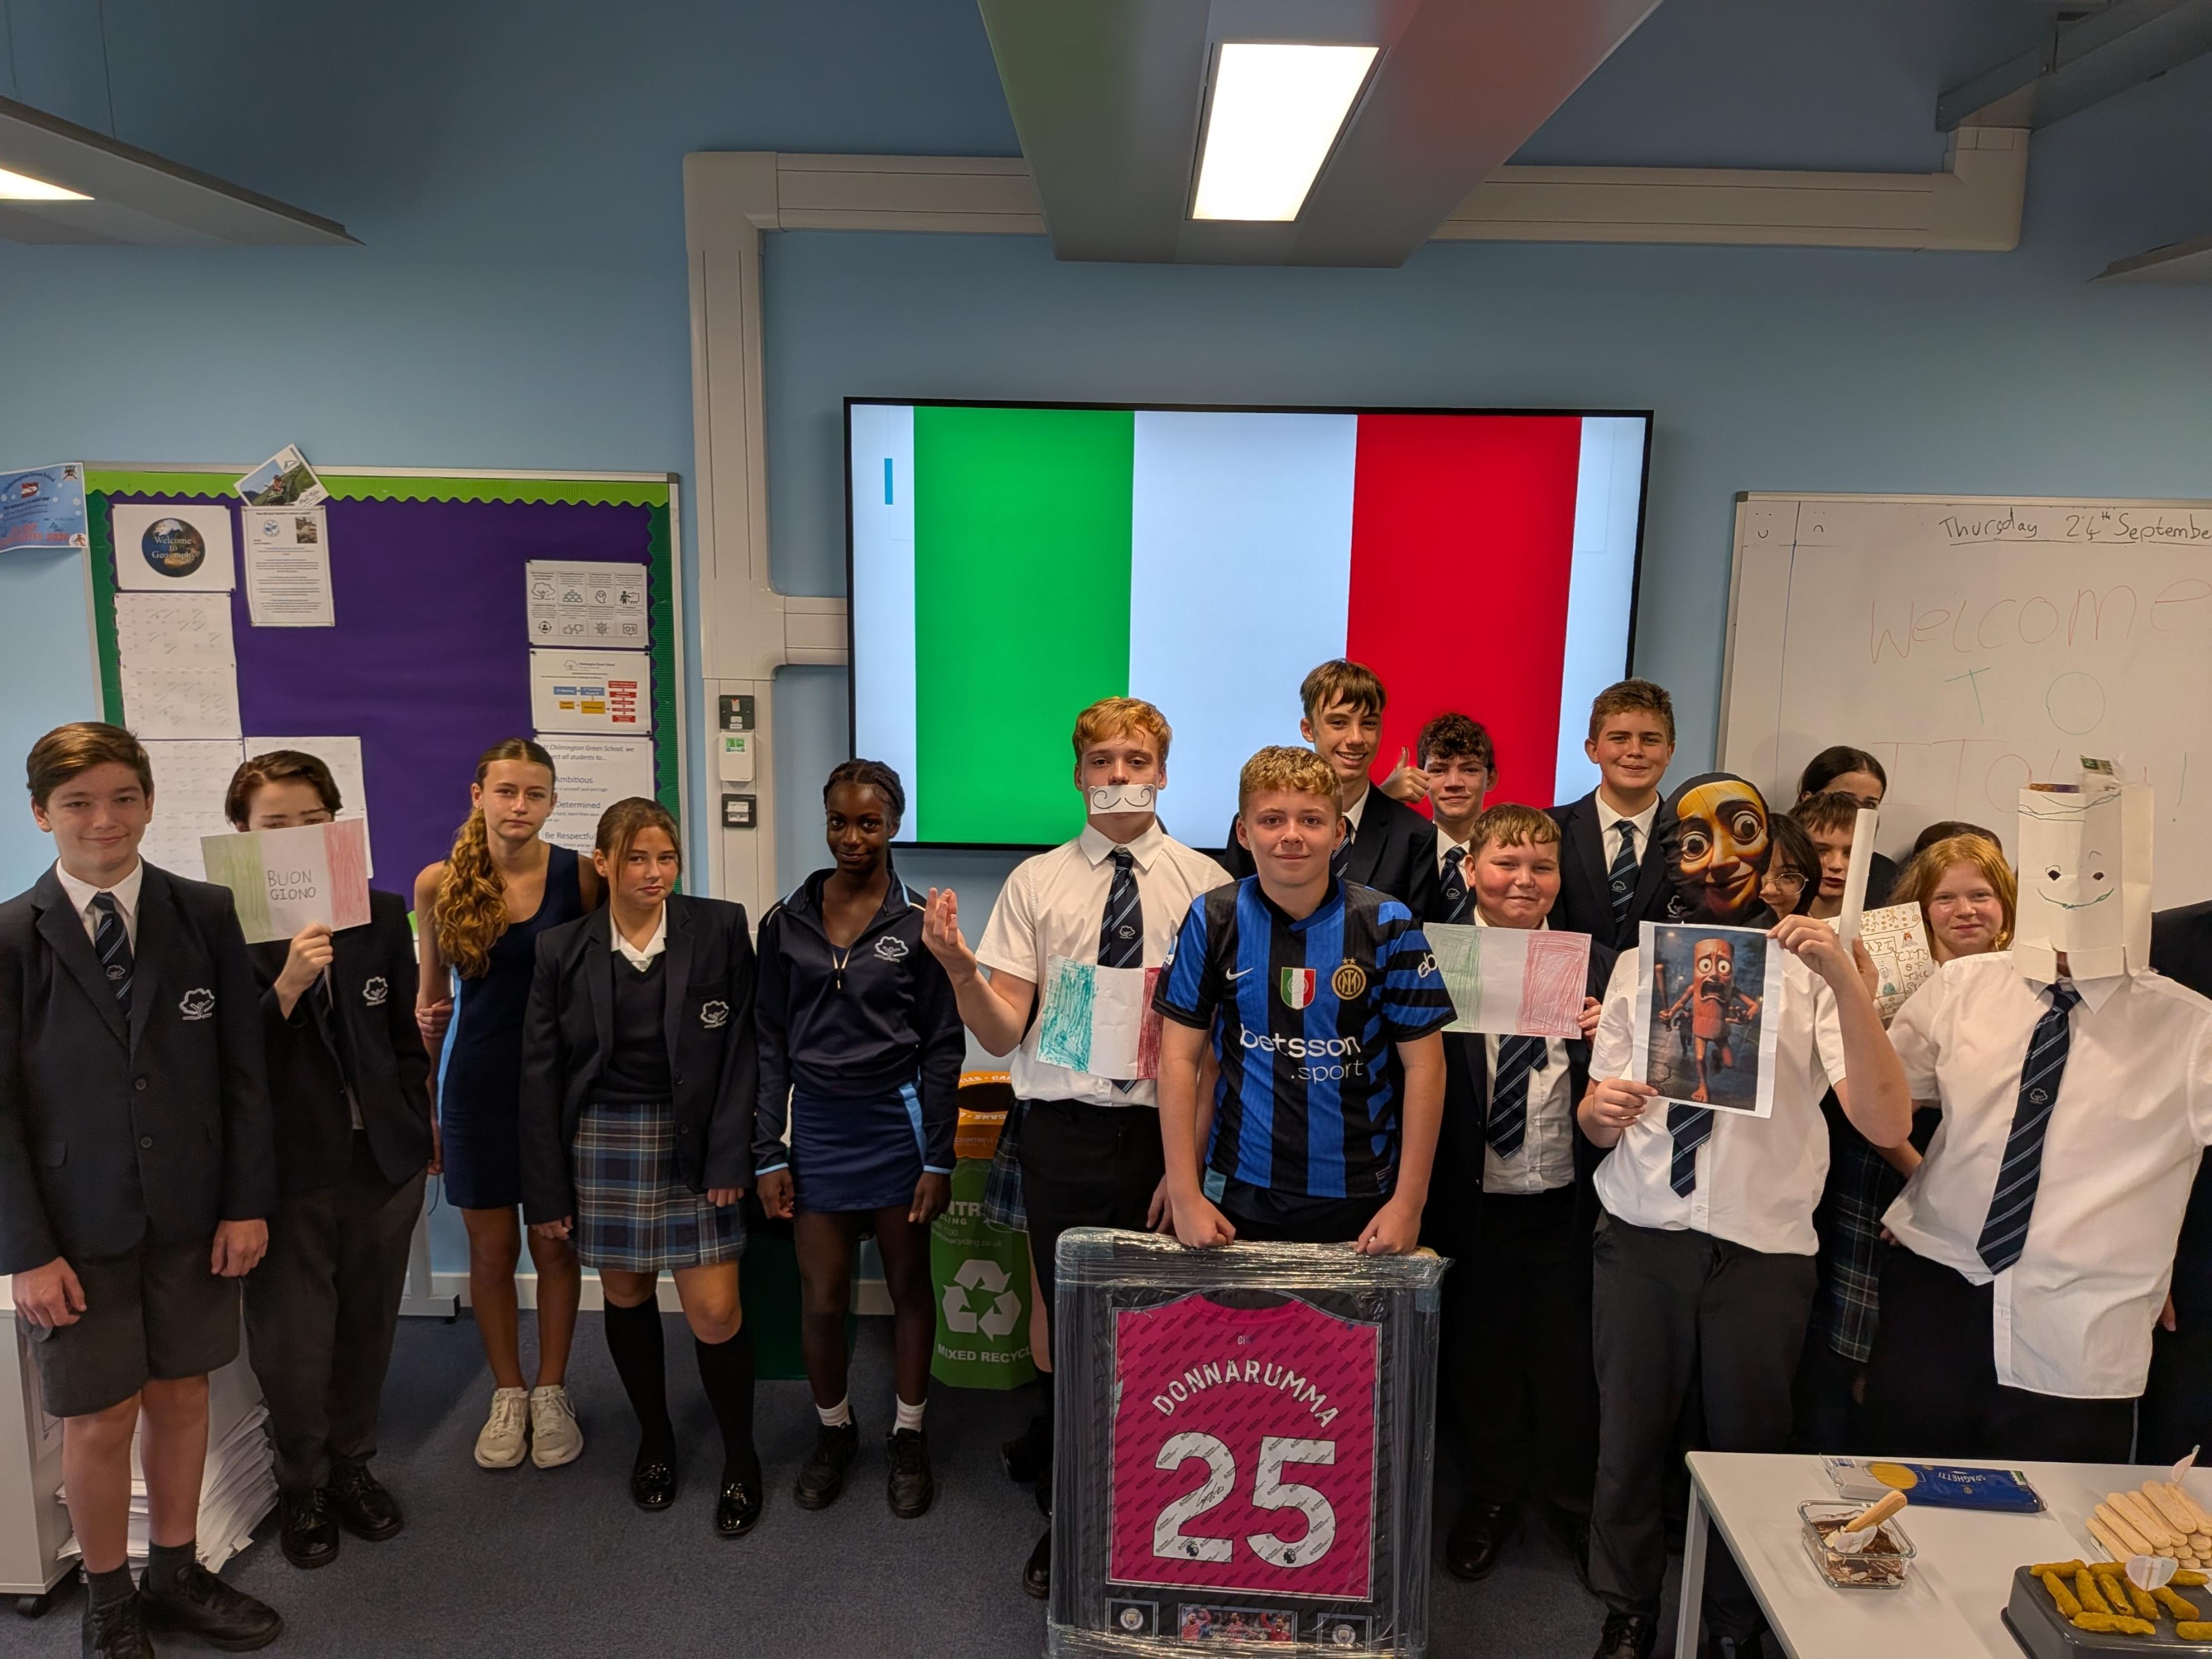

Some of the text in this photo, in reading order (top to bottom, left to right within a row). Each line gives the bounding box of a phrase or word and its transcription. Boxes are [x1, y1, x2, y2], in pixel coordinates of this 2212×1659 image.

[1938, 507, 2038, 538] Thursday
[2114, 512, 2211, 542] Septembe
[154, 535, 192, 544] Welcome
[151, 551, 195, 561] Geography
[1871, 579, 2212, 664] Welcome
[1944, 667, 2106, 735] TO
[268, 869, 312, 887] BUON
[269, 886, 316, 900] GIONO
[1418, 952, 1438, 979] eb
[1898, 948, 1929, 962] CITY
[1903, 970, 1929, 980] THE
[1905, 961, 1924, 972] OF
[1239, 1024, 1361, 1058] betsson
[1291, 1059, 1363, 1085] .sport
[938, 1342, 1031, 1363] MIXED RECYCL
[1152, 1358, 1339, 1428] DONNARUMMA
[1938, 1472, 1986, 1483] SPAGHETTI
[1152, 1431, 1337, 1568] 25
